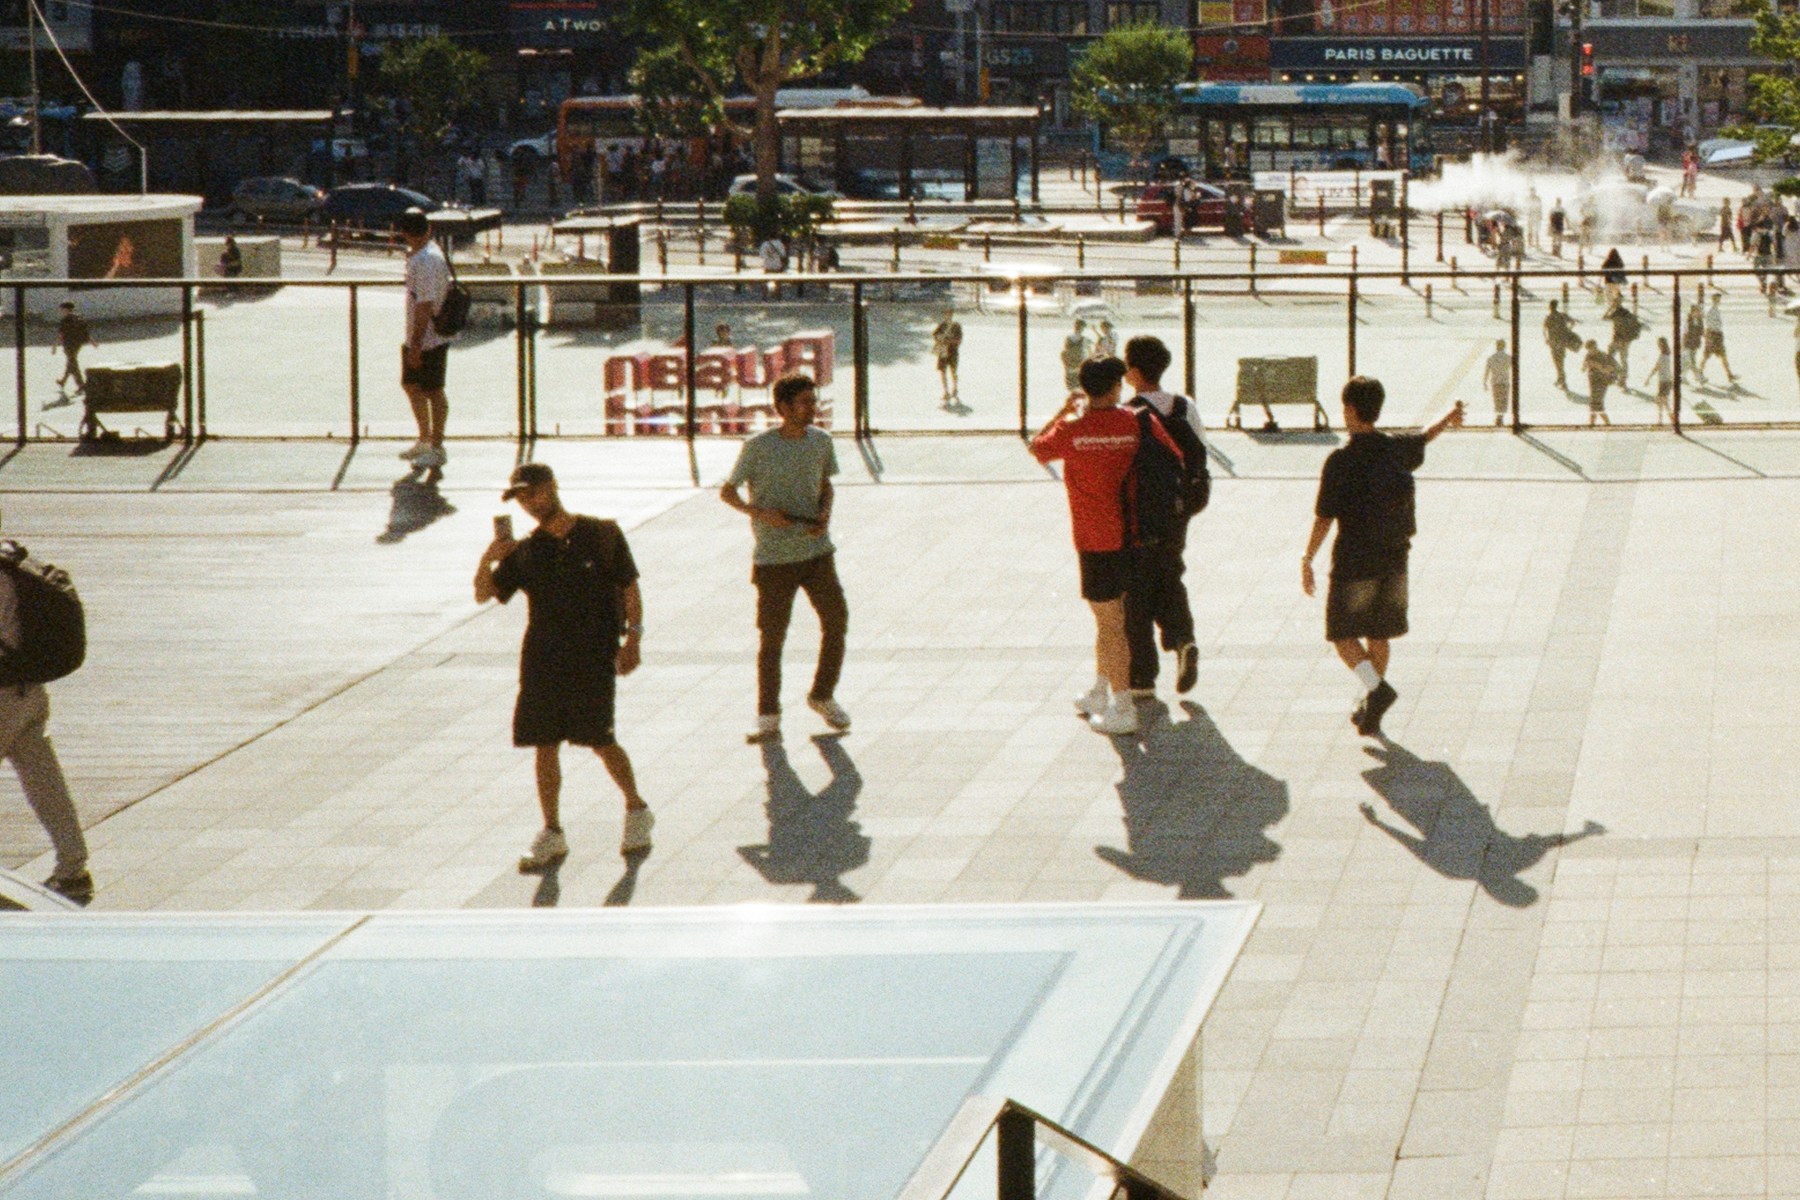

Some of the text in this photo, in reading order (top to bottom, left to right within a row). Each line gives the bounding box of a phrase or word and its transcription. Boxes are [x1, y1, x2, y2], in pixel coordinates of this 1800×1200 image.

[985, 48, 1033, 66] GS25
[1325, 49, 1472, 62] PARIS BAGUETTE
